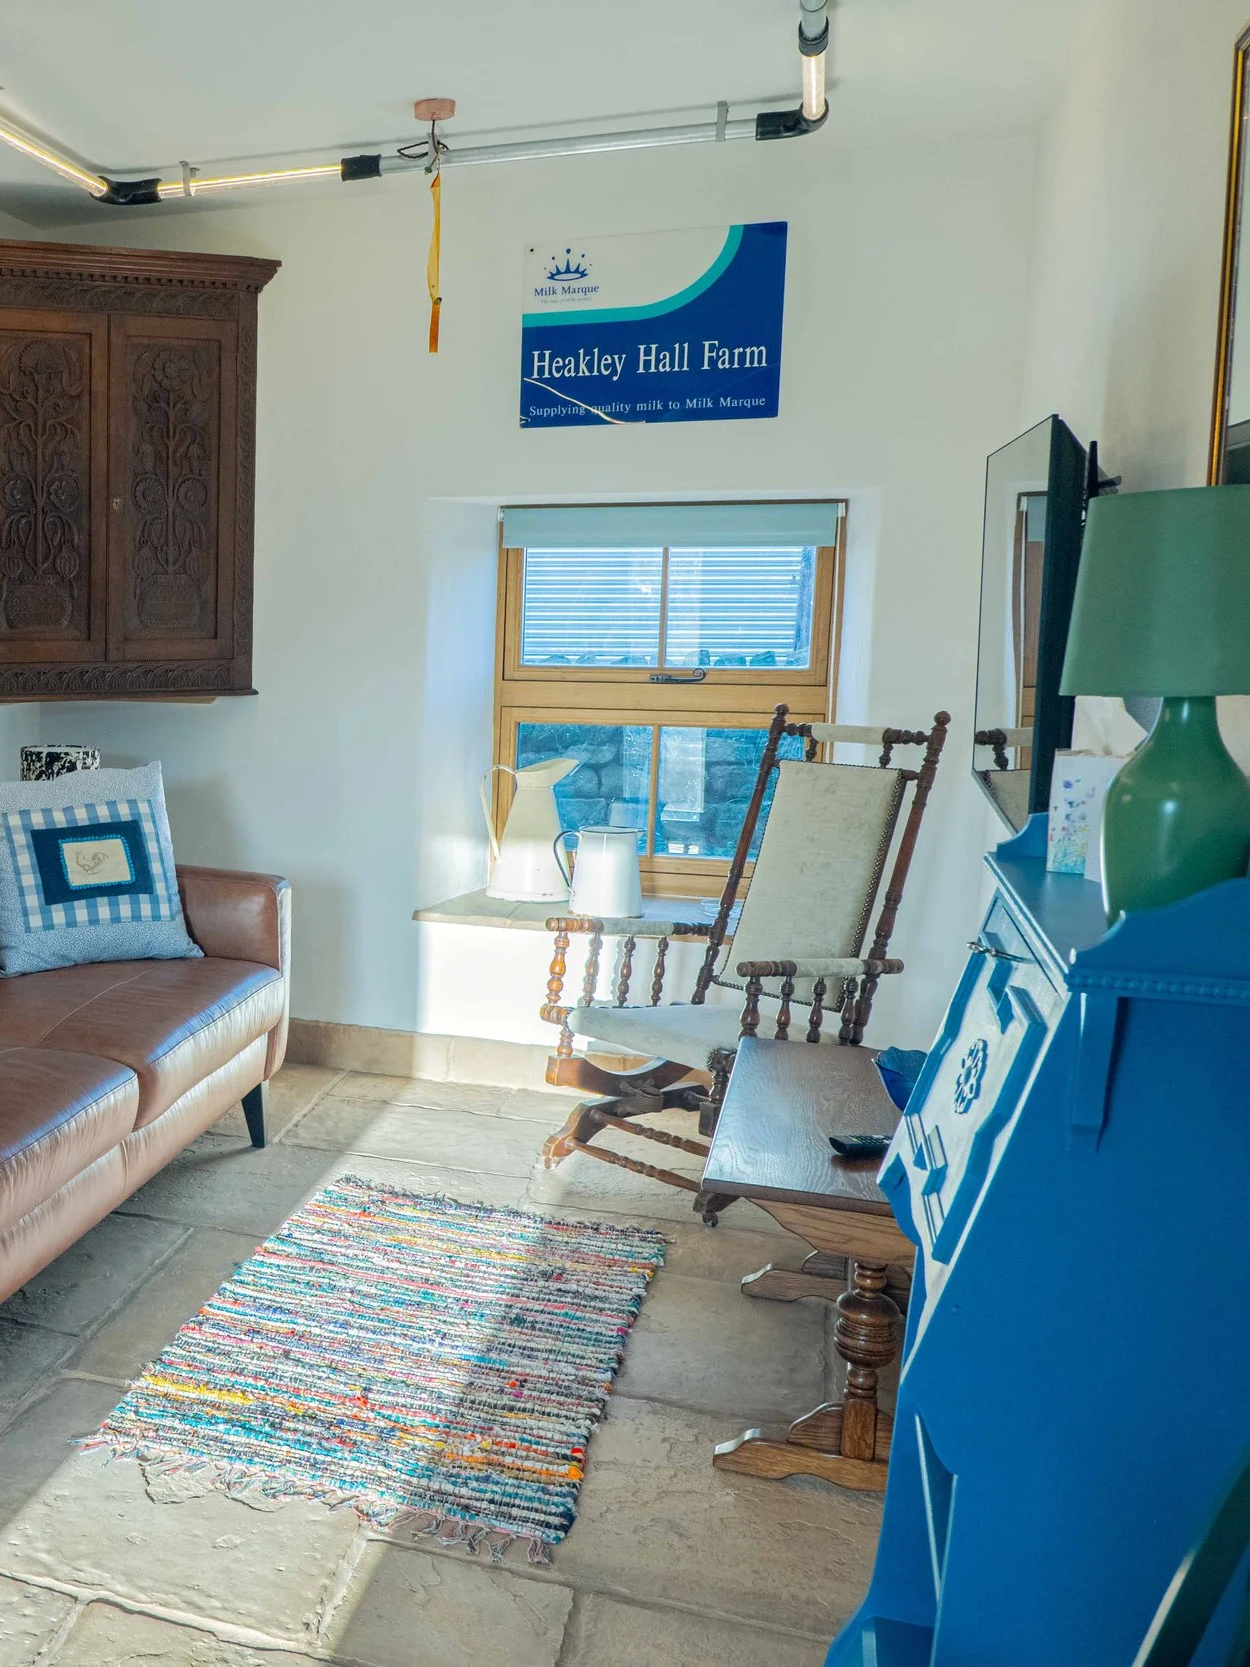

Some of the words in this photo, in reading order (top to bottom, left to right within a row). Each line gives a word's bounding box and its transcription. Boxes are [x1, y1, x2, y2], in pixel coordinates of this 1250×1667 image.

[534, 286, 558, 297] Milk
[561, 285, 600, 296] Marque
[531, 347, 626, 381] Heakley
[636, 342, 690, 374] Hall
[701, 340, 768, 370] Farm
[530, 405, 586, 418] Supplying
[591, 401, 631, 416] quality
[636, 400, 663, 411] milk
[668, 401, 680, 410] to
[686, 398, 714, 409] Milk
[720, 397, 766, 409] Marque
